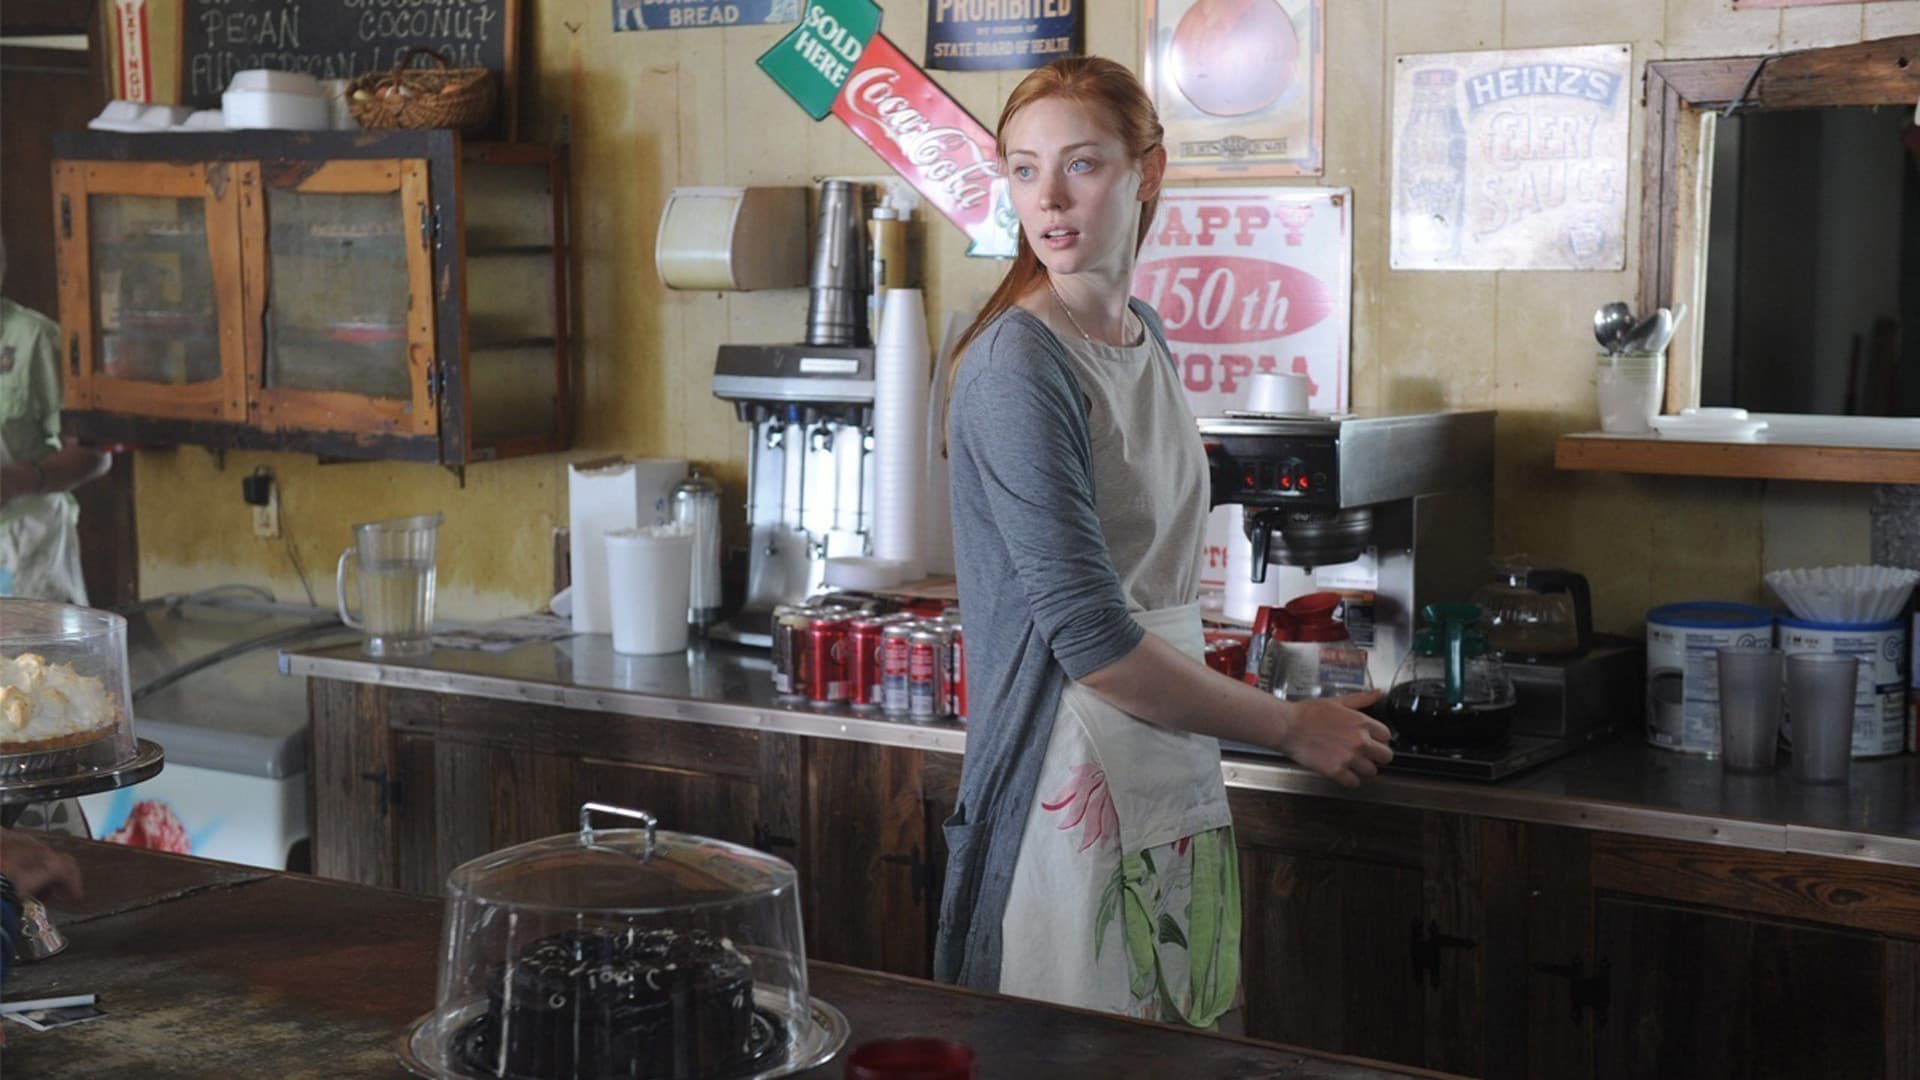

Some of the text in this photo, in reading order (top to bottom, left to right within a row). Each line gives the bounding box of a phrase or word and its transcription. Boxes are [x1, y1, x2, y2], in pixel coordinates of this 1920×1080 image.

[200, 6, 300, 48] PECAN
[358, 6, 496, 42] COCONUT
[668, 5, 740, 27] BREAD
[934, 0, 1072, 23] PROHIBITED
[806, 5, 862, 62] SOLD
[933, 37, 1070, 57] STATE BOARD OF HEALTH
[794, 30, 849, 88] HERE
[1472, 65, 1611, 105] HEINZ'S
[844, 67, 1005, 208] Coca-Cola
[1473, 160, 1617, 235] SAUCE
[1148, 204, 1314, 246] APPY
